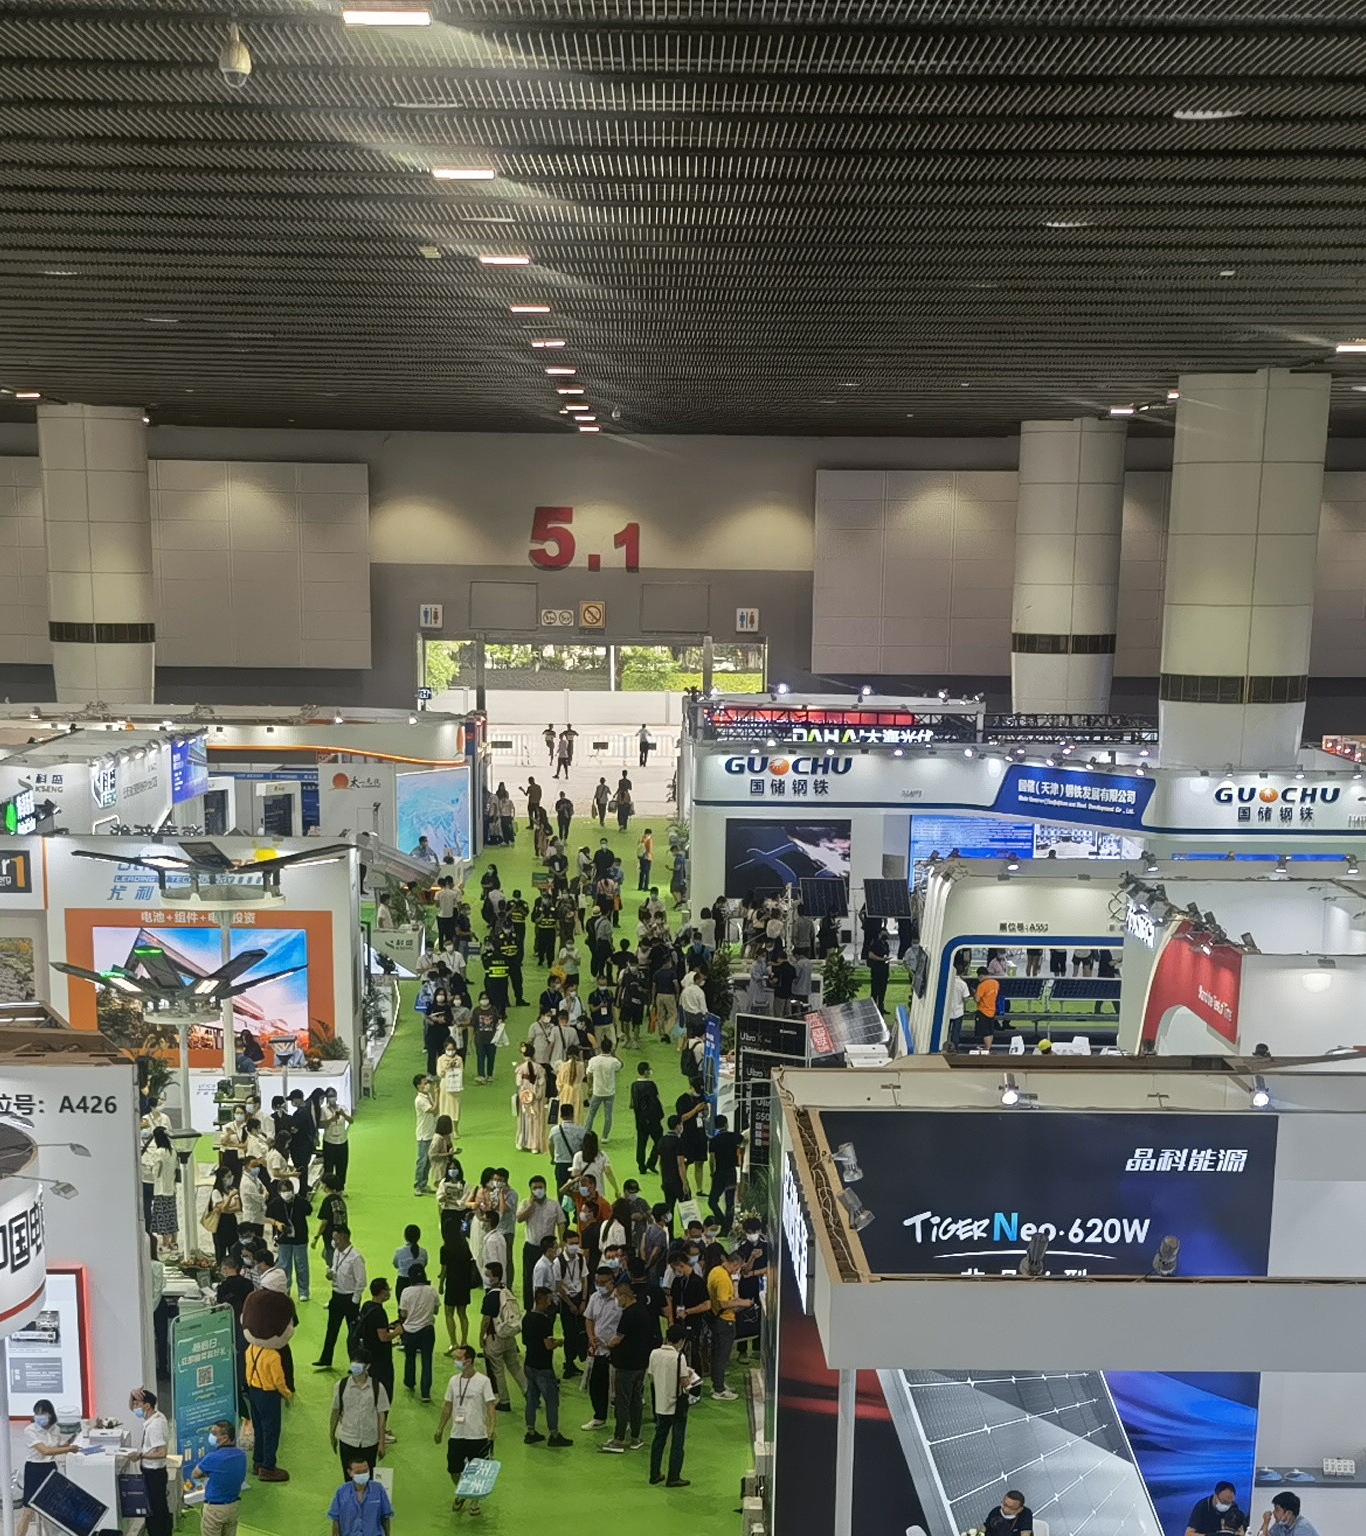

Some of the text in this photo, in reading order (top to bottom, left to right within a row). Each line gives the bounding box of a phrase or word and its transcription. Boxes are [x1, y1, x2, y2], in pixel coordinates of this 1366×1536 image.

[528, 506, 641, 573] 5.1
[750, 778, 829, 796] 国储钢铁
[1237, 805, 1315, 822] 国储钢铁
[58, 1094, 117, 1115] A426
[1125, 1148, 1249, 1173] 晶科能源
